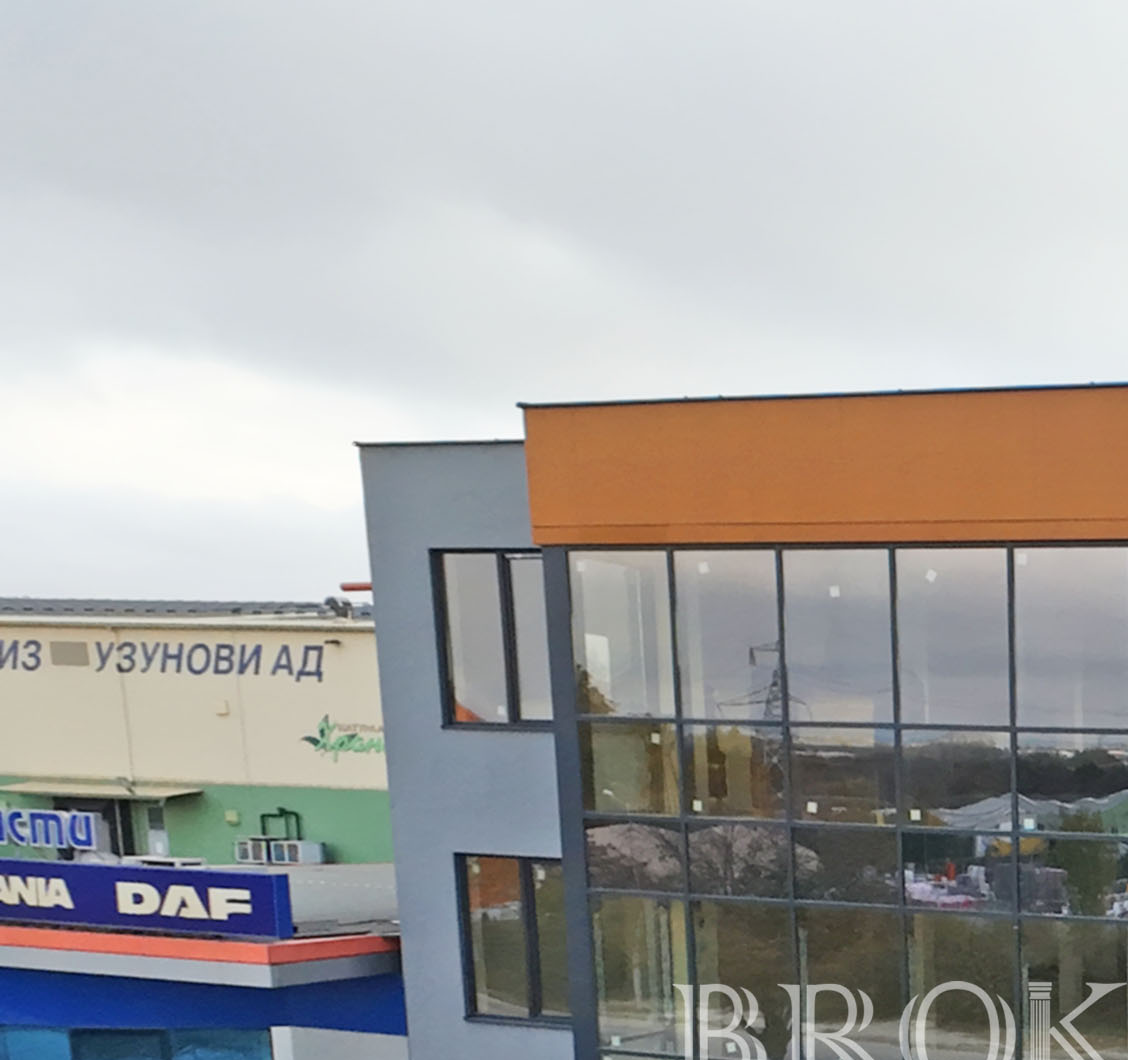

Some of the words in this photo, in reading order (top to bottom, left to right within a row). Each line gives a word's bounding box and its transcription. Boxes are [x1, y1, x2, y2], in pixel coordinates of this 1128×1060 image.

[95, 641, 263, 675] УЗУНОВИ
[271, 644, 324, 683] АД
[0, 810, 95, 849] сти
[115, 881, 252, 921] DAF
